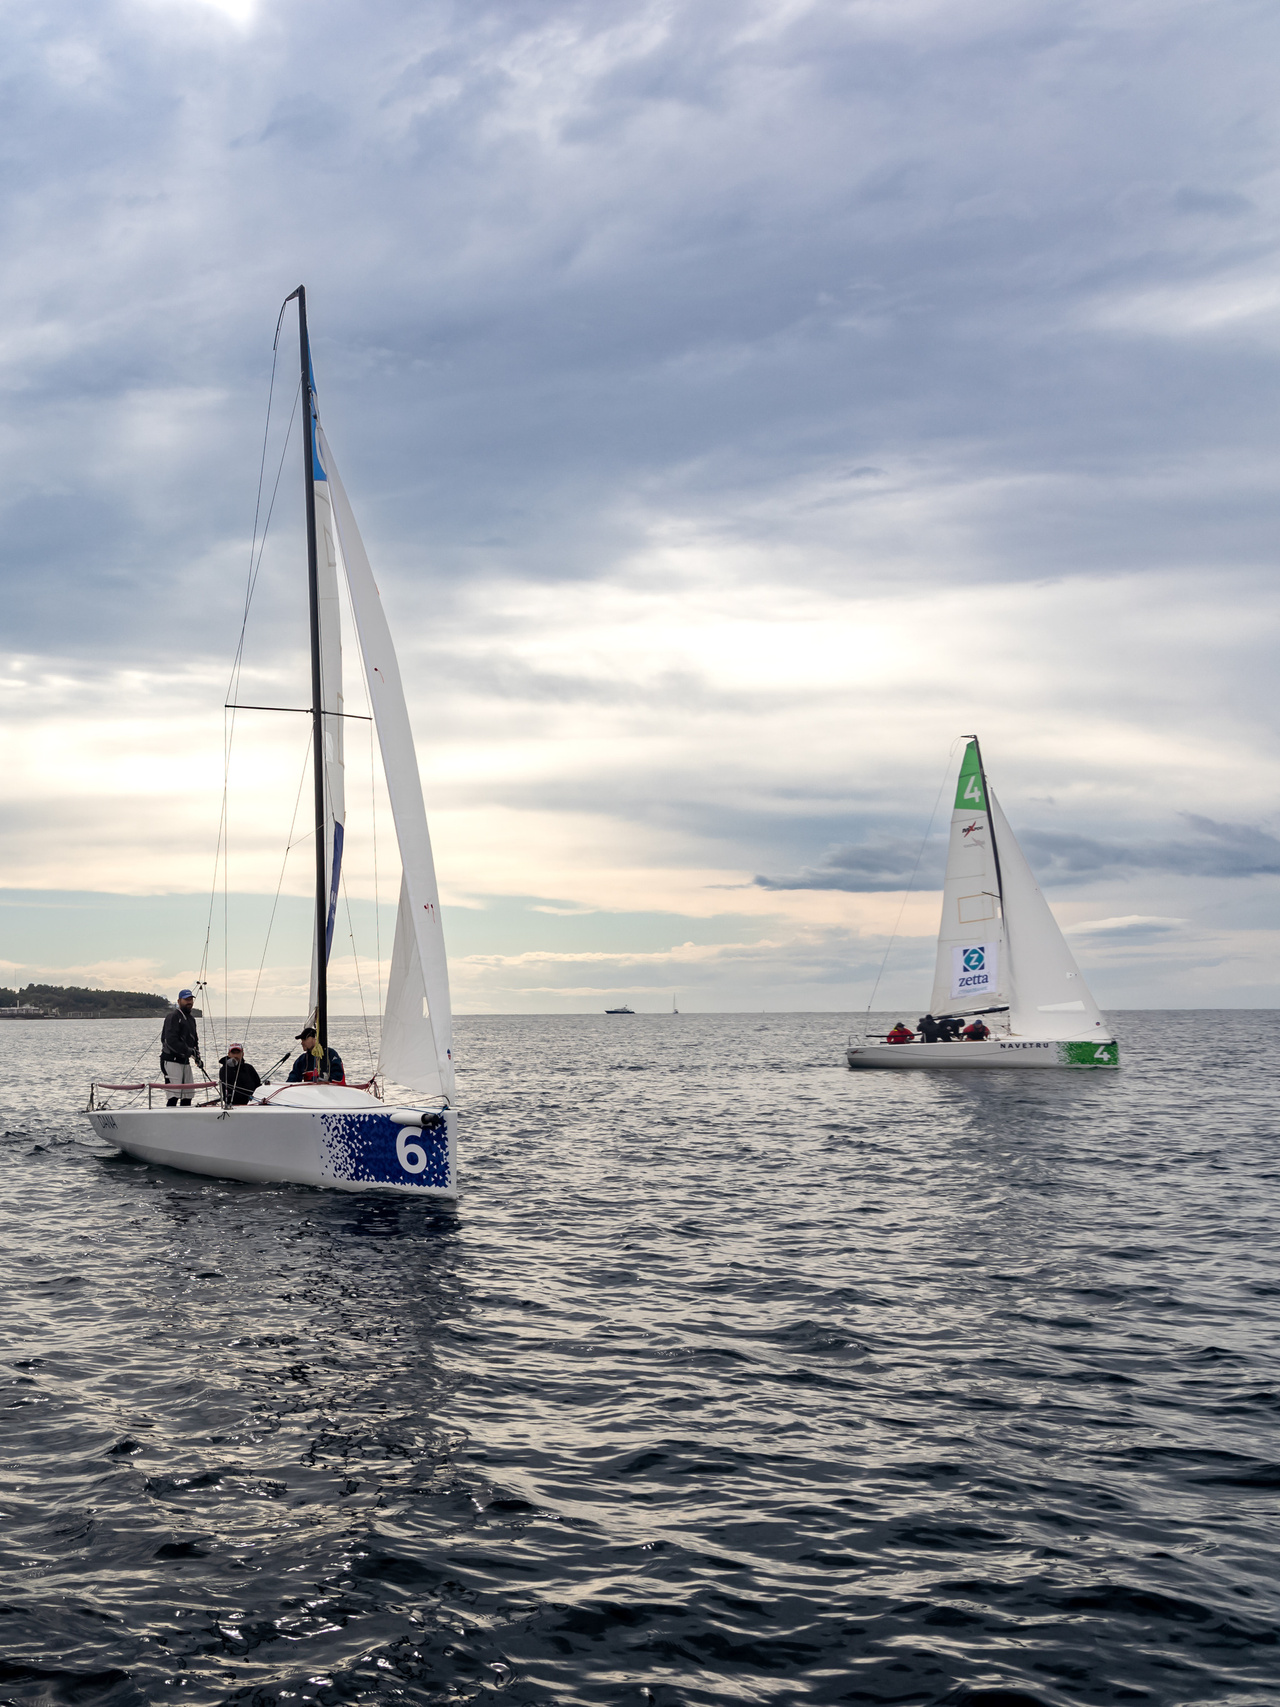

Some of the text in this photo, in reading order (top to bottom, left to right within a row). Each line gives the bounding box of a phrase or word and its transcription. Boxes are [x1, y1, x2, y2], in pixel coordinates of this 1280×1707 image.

[963, 775, 981, 803] 4
[958, 974, 989, 987] zetta
[1093, 1045, 1111, 1062] 4
[395, 1125, 428, 1174] 6
